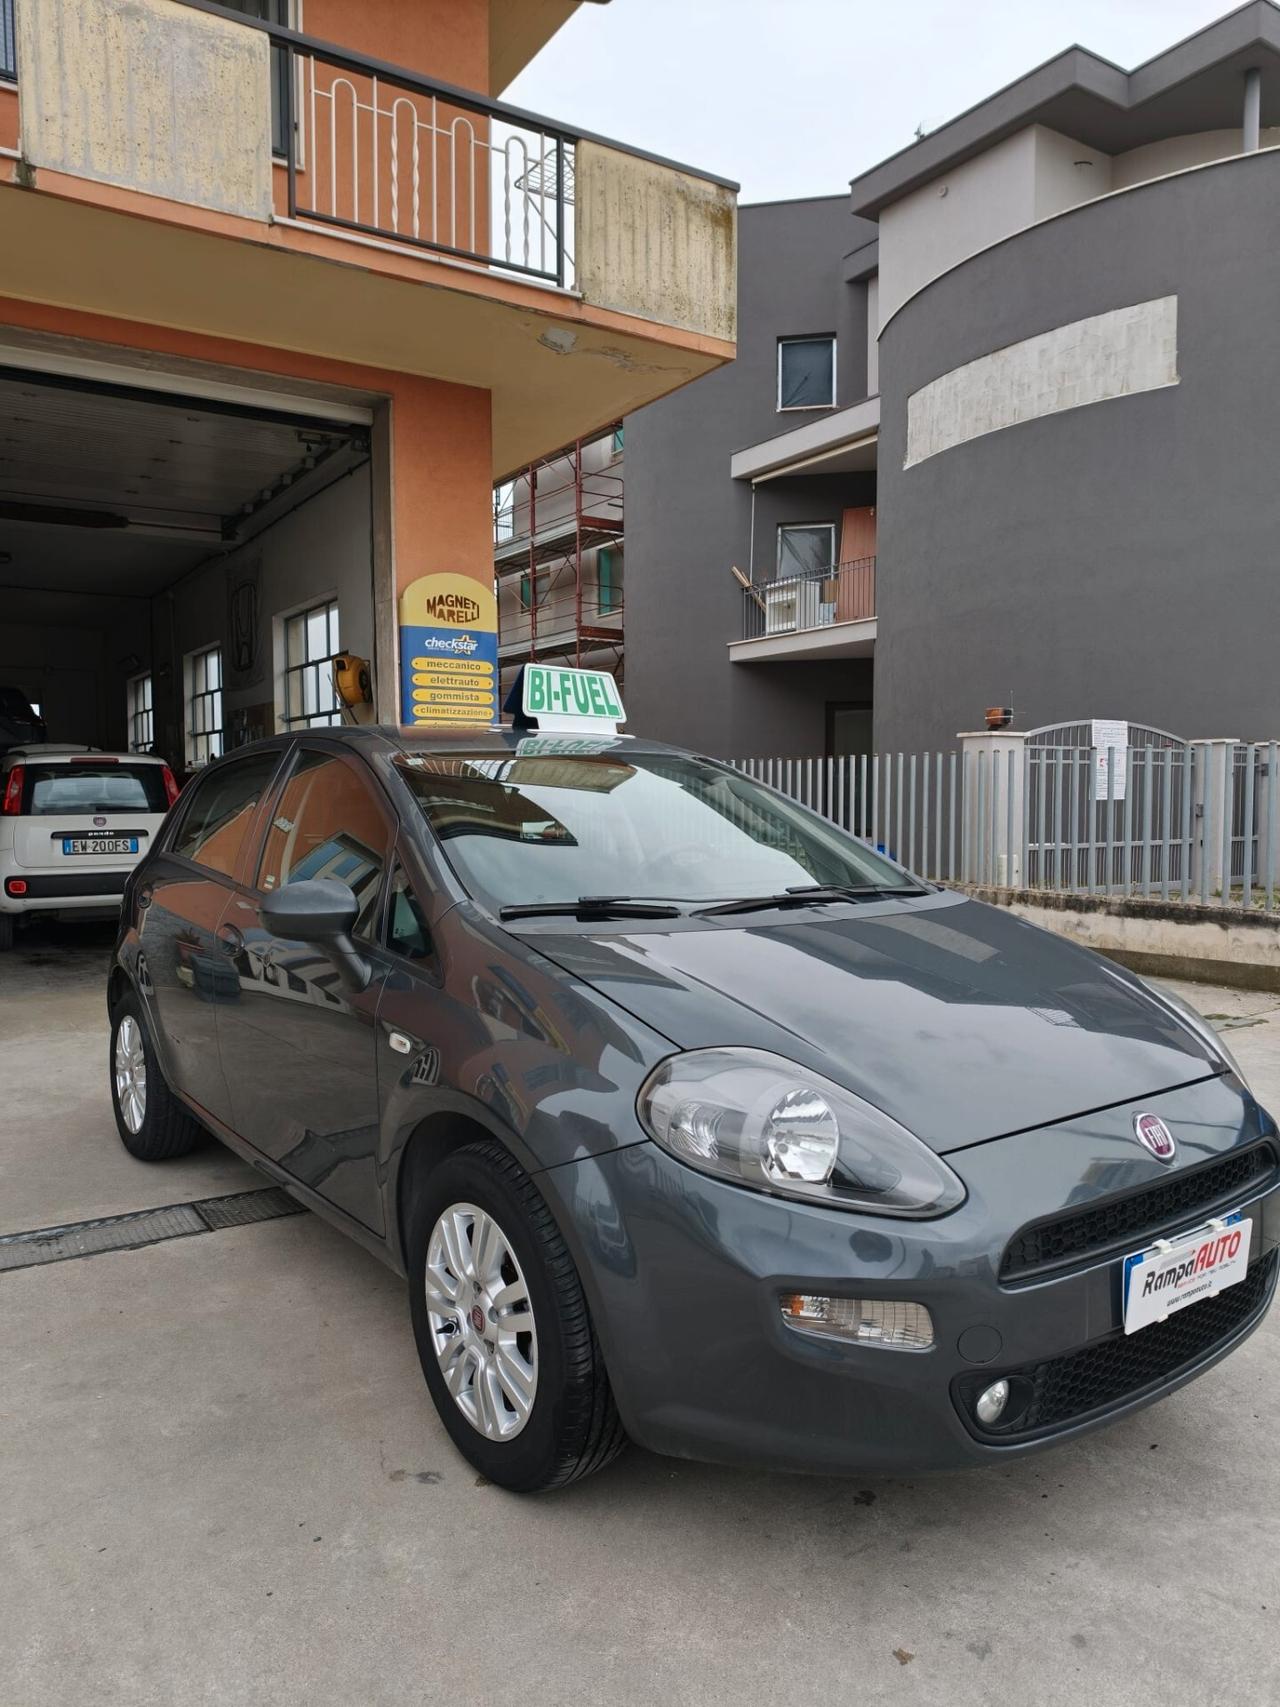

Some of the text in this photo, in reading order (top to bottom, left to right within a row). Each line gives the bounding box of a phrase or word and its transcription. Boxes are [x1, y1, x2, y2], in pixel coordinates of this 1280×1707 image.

[426, 594, 479, 612] MAGNETI
[424, 636, 478, 651] checkstar
[427, 660, 481, 671] meccanico
[430, 675, 479, 687] elettrauto
[430, 690, 480, 702] gommista
[529, 670, 620, 716] BI-FUEL
[420, 705, 488, 717] climatizzazione
[72, 840, 129, 852] EW 200FS
[1144, 1124, 1168, 1149] FIAT
